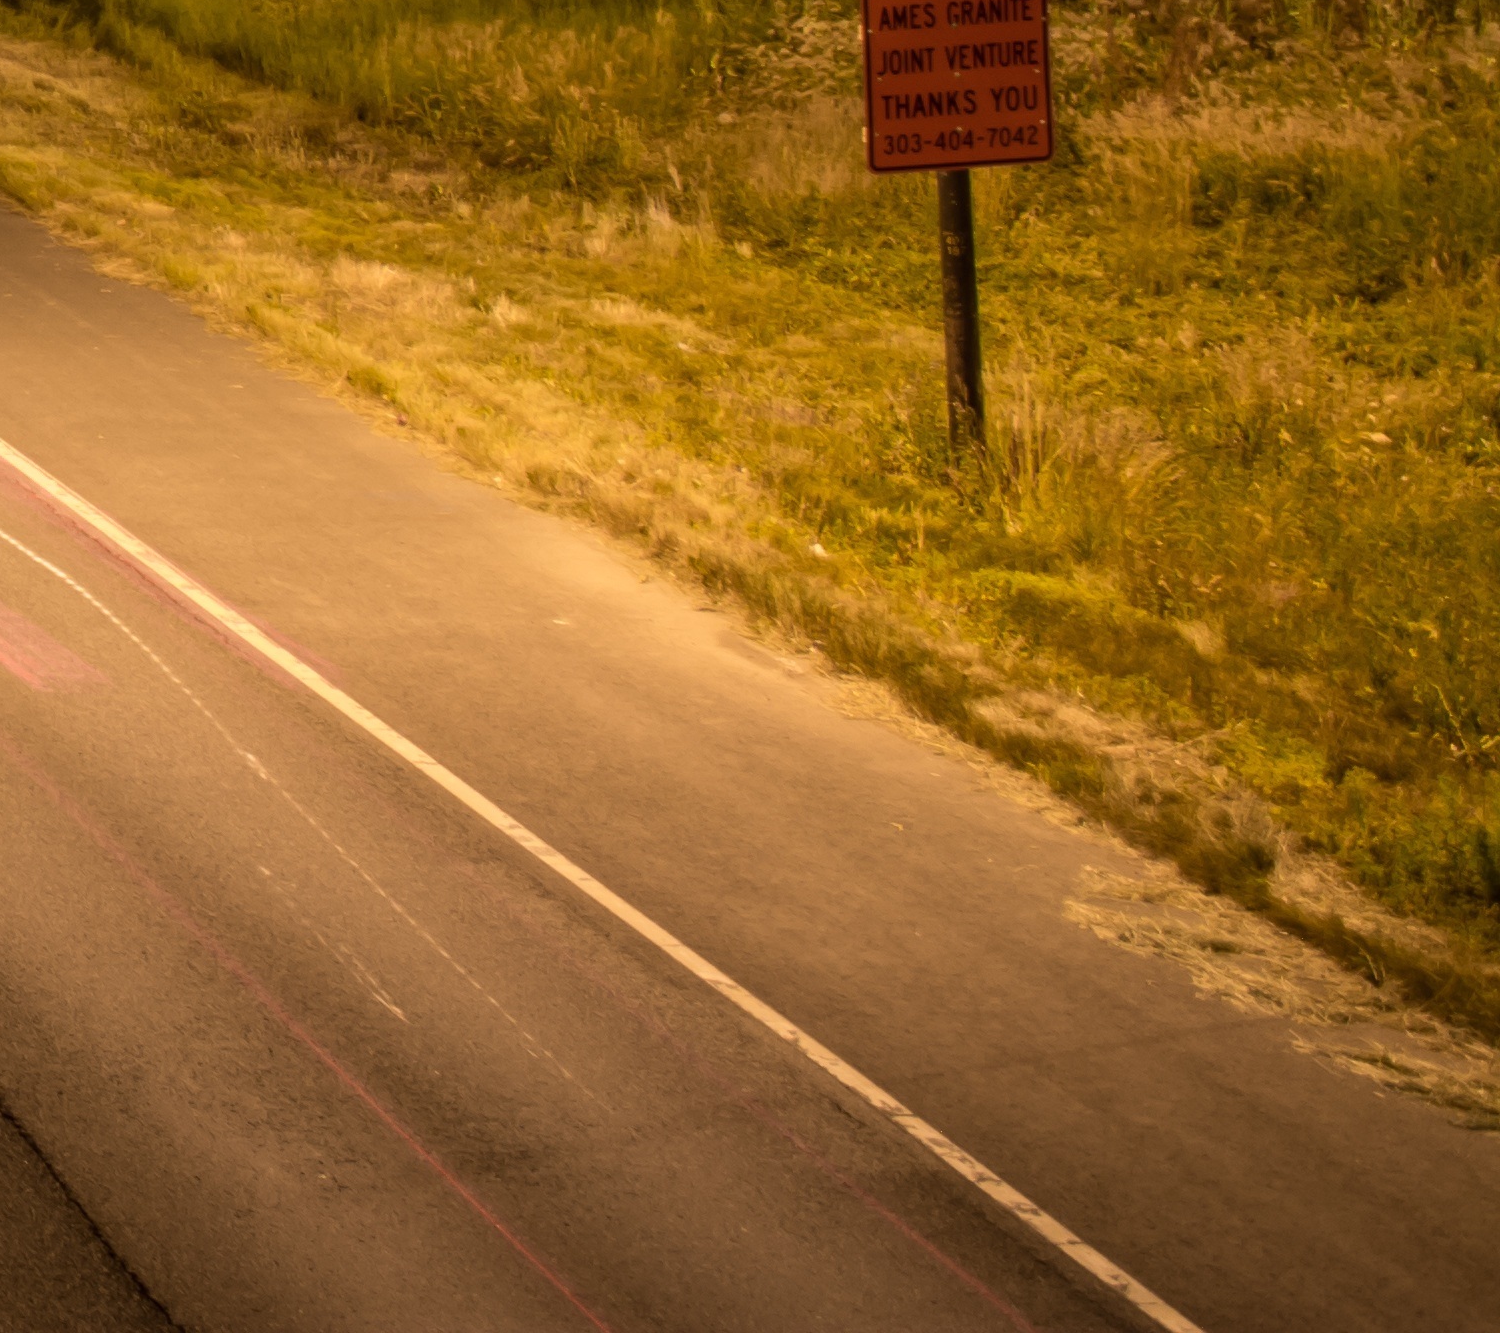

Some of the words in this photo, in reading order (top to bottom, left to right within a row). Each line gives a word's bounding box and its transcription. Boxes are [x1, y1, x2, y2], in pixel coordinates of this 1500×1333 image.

[878, 3, 937, 32] AMES
[876, 47, 935, 76] JOINT
[945, 39, 1039, 70] VENTURE
[881, 89, 977, 120] THANKS
[990, 85, 1038, 113] YOU
[882, 124, 1039, 155] 303-404-7042
